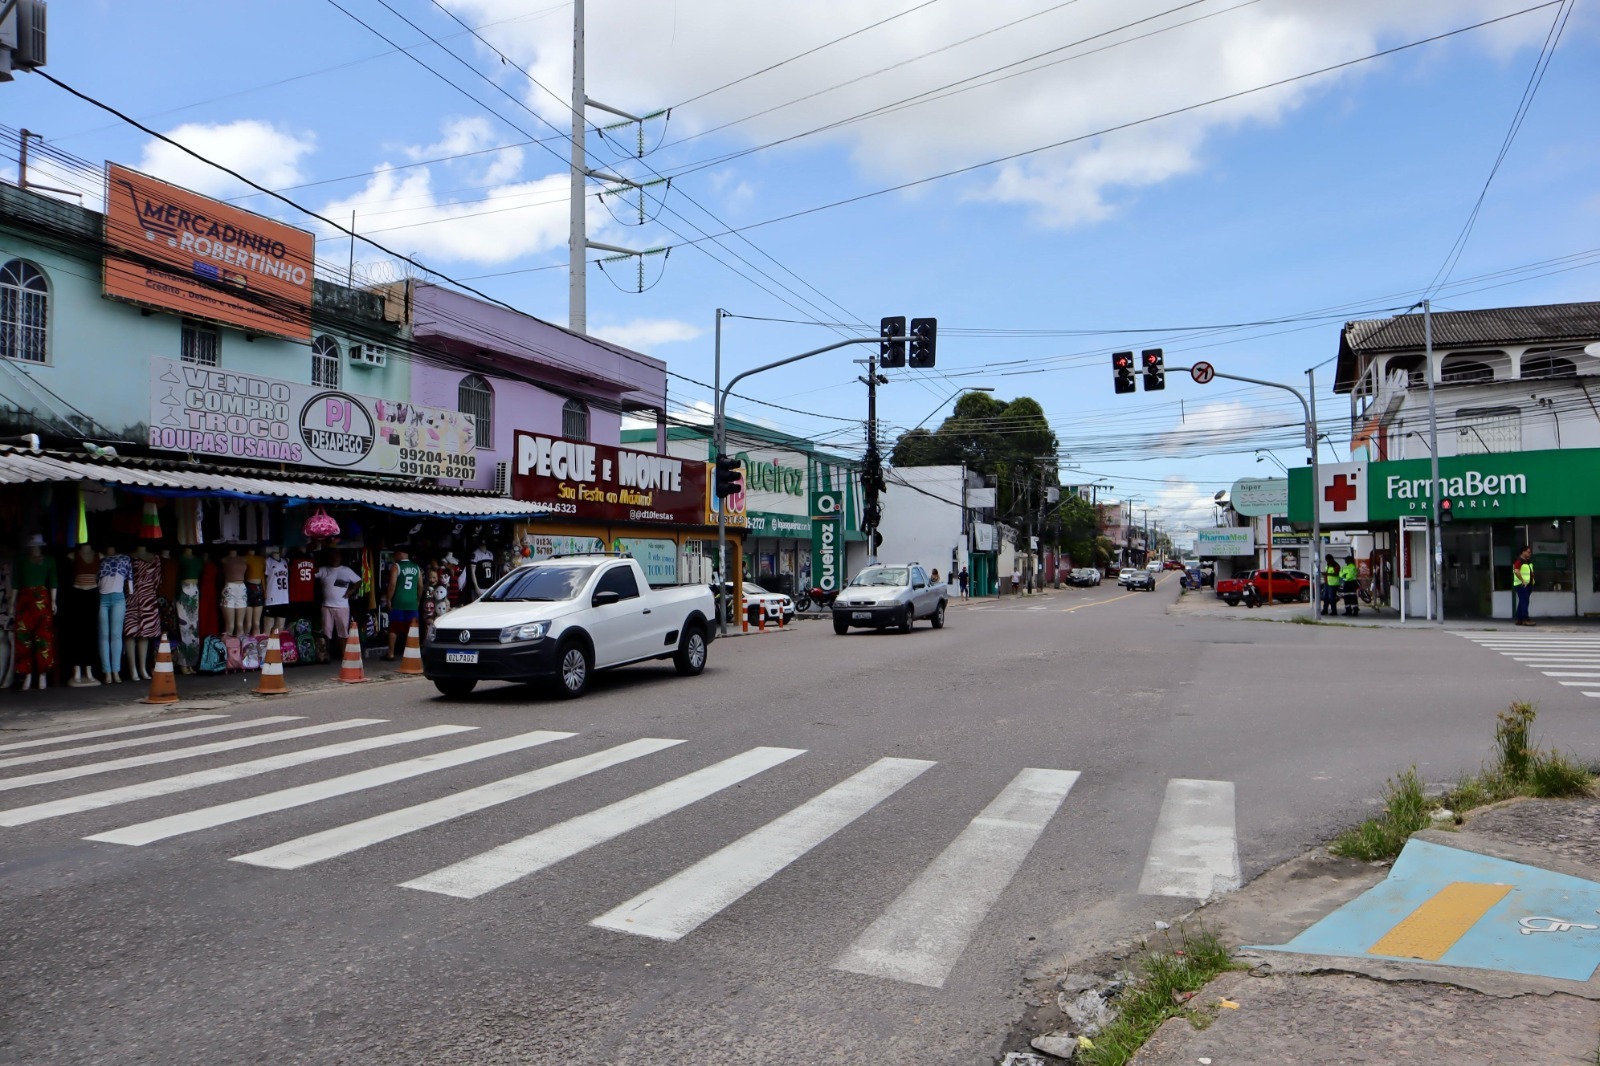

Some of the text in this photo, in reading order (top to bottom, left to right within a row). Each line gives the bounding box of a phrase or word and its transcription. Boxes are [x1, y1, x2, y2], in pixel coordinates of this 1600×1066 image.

[144, 199, 286, 259] MERCADINHO
[180, 231, 306, 285] ROBERTINHO
[182, 366, 290, 402] VENDO
[185, 388, 289, 422] COMPRO
[325, 398, 352, 434] PJ
[183, 409, 289, 440] TROCO
[149, 425, 302, 461] ROUPAS USADAS
[311, 431, 363, 454] DESAPEGO
[399, 448, 476, 468] 99204-1408
[399, 461, 476, 480] 99143-8207
[517, 434, 597, 482] PEGUE
[602, 458, 612, 481] E
[618, 450, 683, 492] MONTE
[557, 482, 576, 500] Sua
[578, 483, 605, 503] Festa
[1387, 471, 1526, 499] FarmaBem
[1409, 500, 1499, 510] DRARIA
[1199, 533, 1249, 541] PharmaMed
[819, 523, 836, 591] Queiroz
[300, 568, 312, 581] 95
[404, 575, 413, 590] 5
